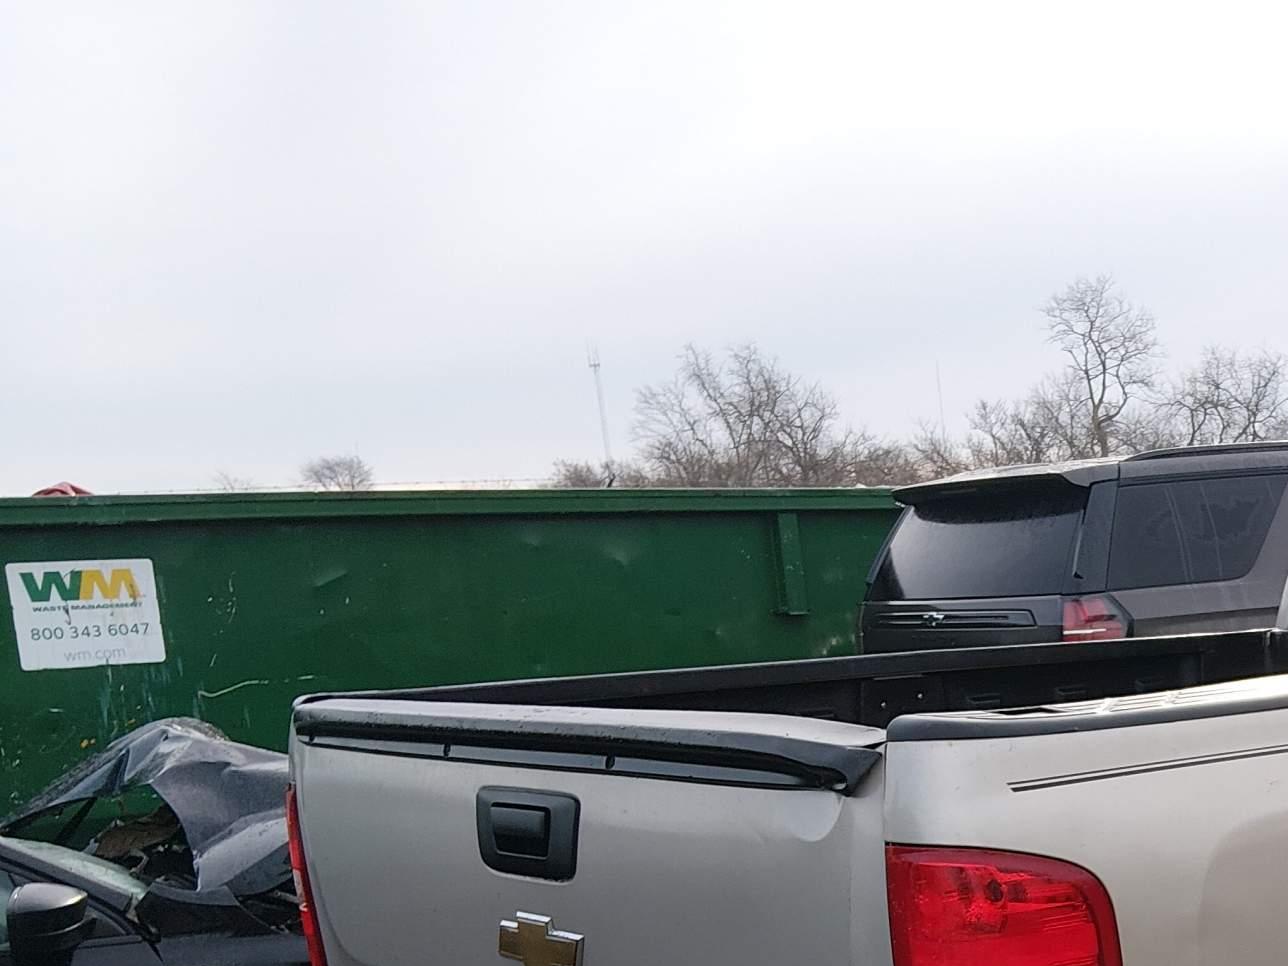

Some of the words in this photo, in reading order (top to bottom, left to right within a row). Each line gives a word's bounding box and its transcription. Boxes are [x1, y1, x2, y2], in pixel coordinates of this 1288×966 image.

[19, 568, 140, 603] WM
[32, 604, 69, 613] WASTE
[70, 601, 144, 611] MANAGEMENT
[30, 627, 65, 641] 800
[69, 624, 102, 639] 343
[108, 622, 150, 637] 6047
[63, 647, 126, 662] wm.com
